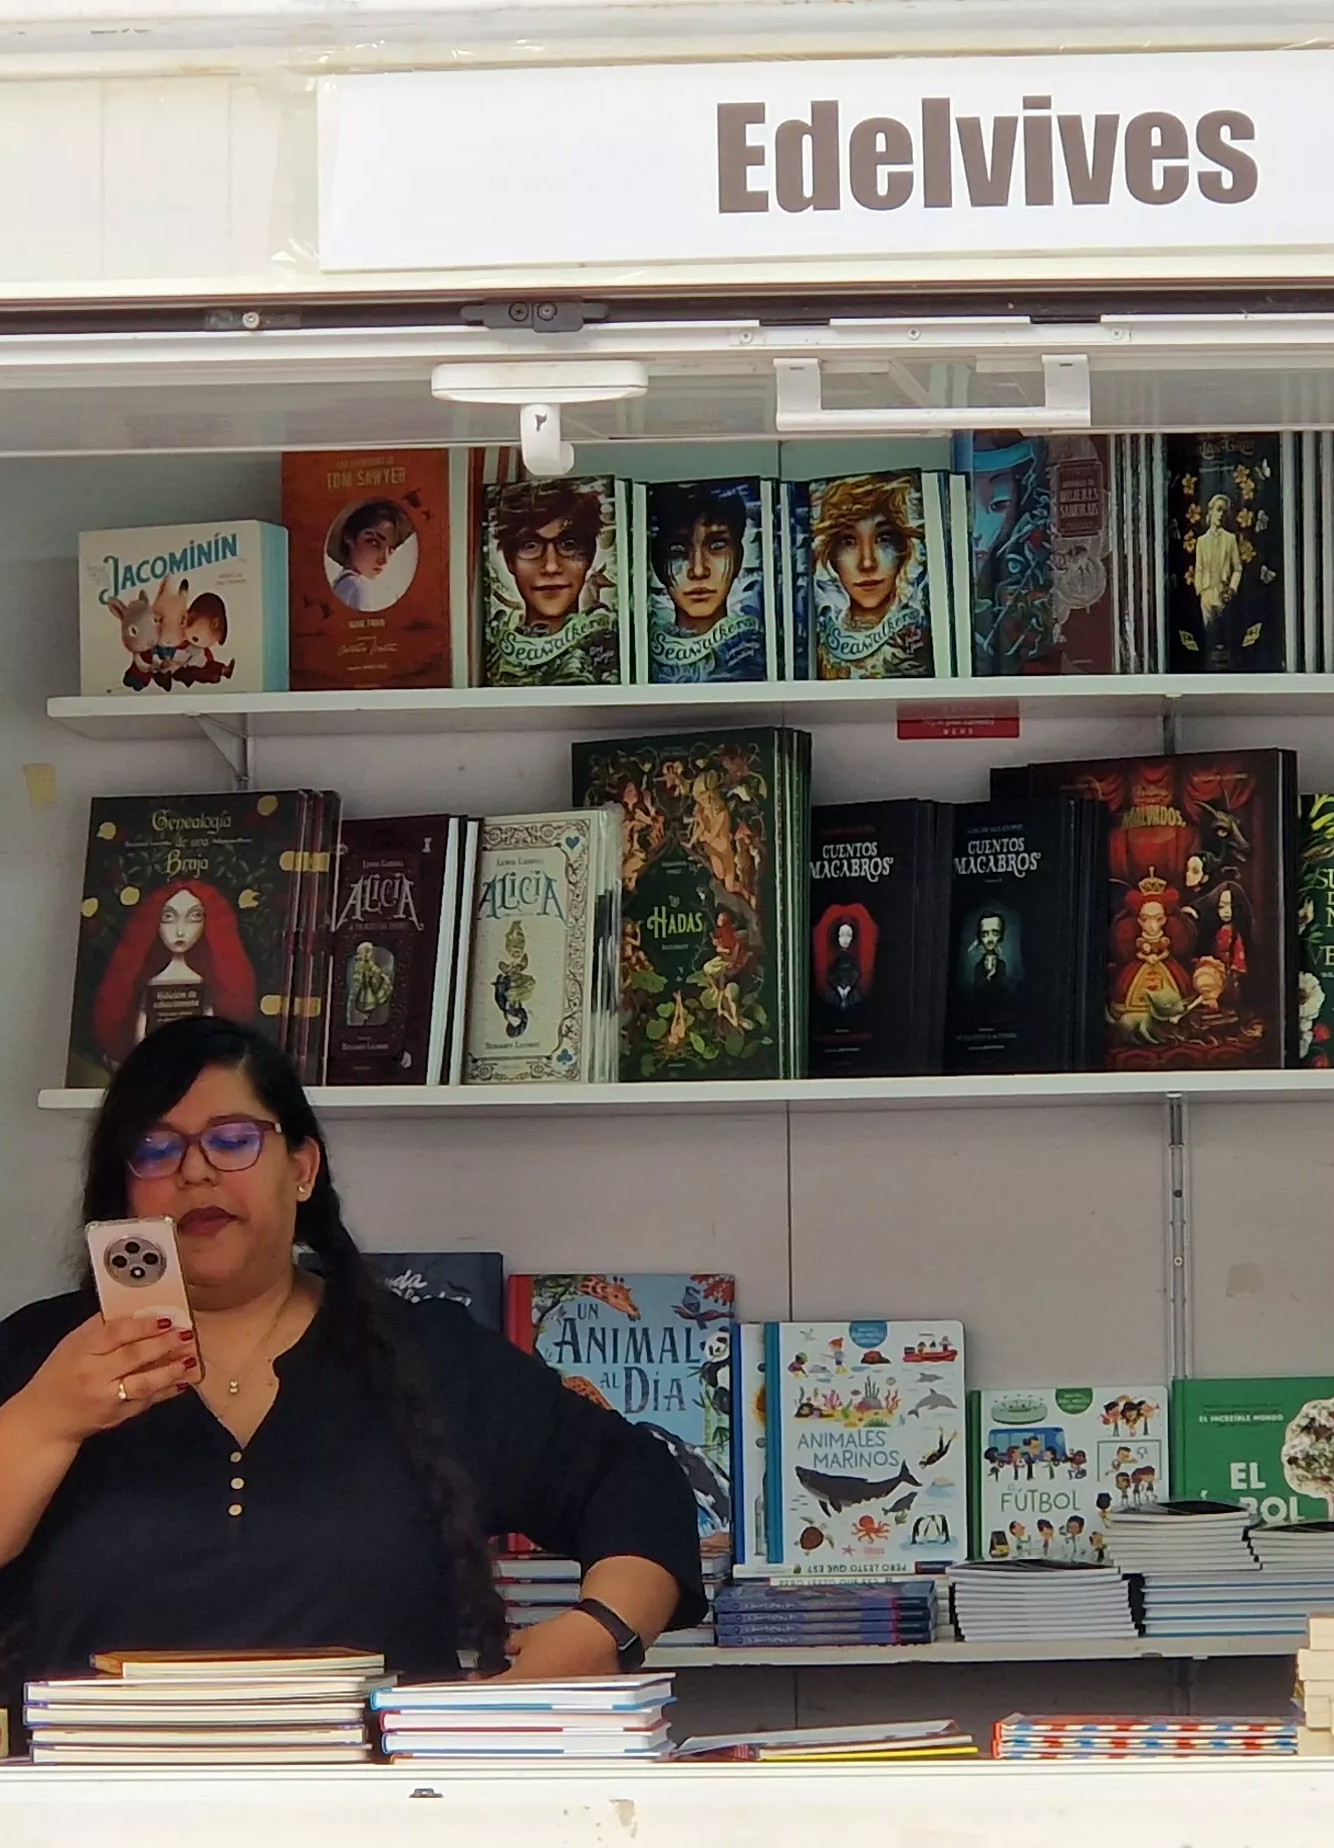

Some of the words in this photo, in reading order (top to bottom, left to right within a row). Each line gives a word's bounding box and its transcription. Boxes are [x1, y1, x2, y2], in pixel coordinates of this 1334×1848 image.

[717, 95, 1259, 214] Edelvives
[327, 471, 352, 489] TOM
[357, 466, 406, 487] SAWYER
[500, 609, 612, 660] Seawalkers
[651, 616, 757, 660] Seawalkers
[825, 608, 920, 656] Seawalkers
[152, 808, 232, 835] Genealogía
[822, 842, 878, 859] CUENTOS
[968, 837, 1025, 855] CUENTOS
[162, 848, 209, 882] Bruja
[809, 856, 894, 883] MACABROS
[954, 852, 1041, 878] MACABROS
[332, 872, 425, 931] ALICIA
[477, 870, 571, 928] ALICIA
[646, 905, 704, 939] HADAS
[577, 1303, 600, 1320] UN
[552, 1317, 702, 1365] ANIMAL
[599, 1372, 621, 1390] AL
[623, 1365, 687, 1415] DÍA
[797, 1428, 887, 1450] ANIMALES
[813, 1449, 900, 1470] MARINOS
[1230, 1462, 1267, 1490] EL
[1000, 1488, 1082, 1514] FÚTBOL
